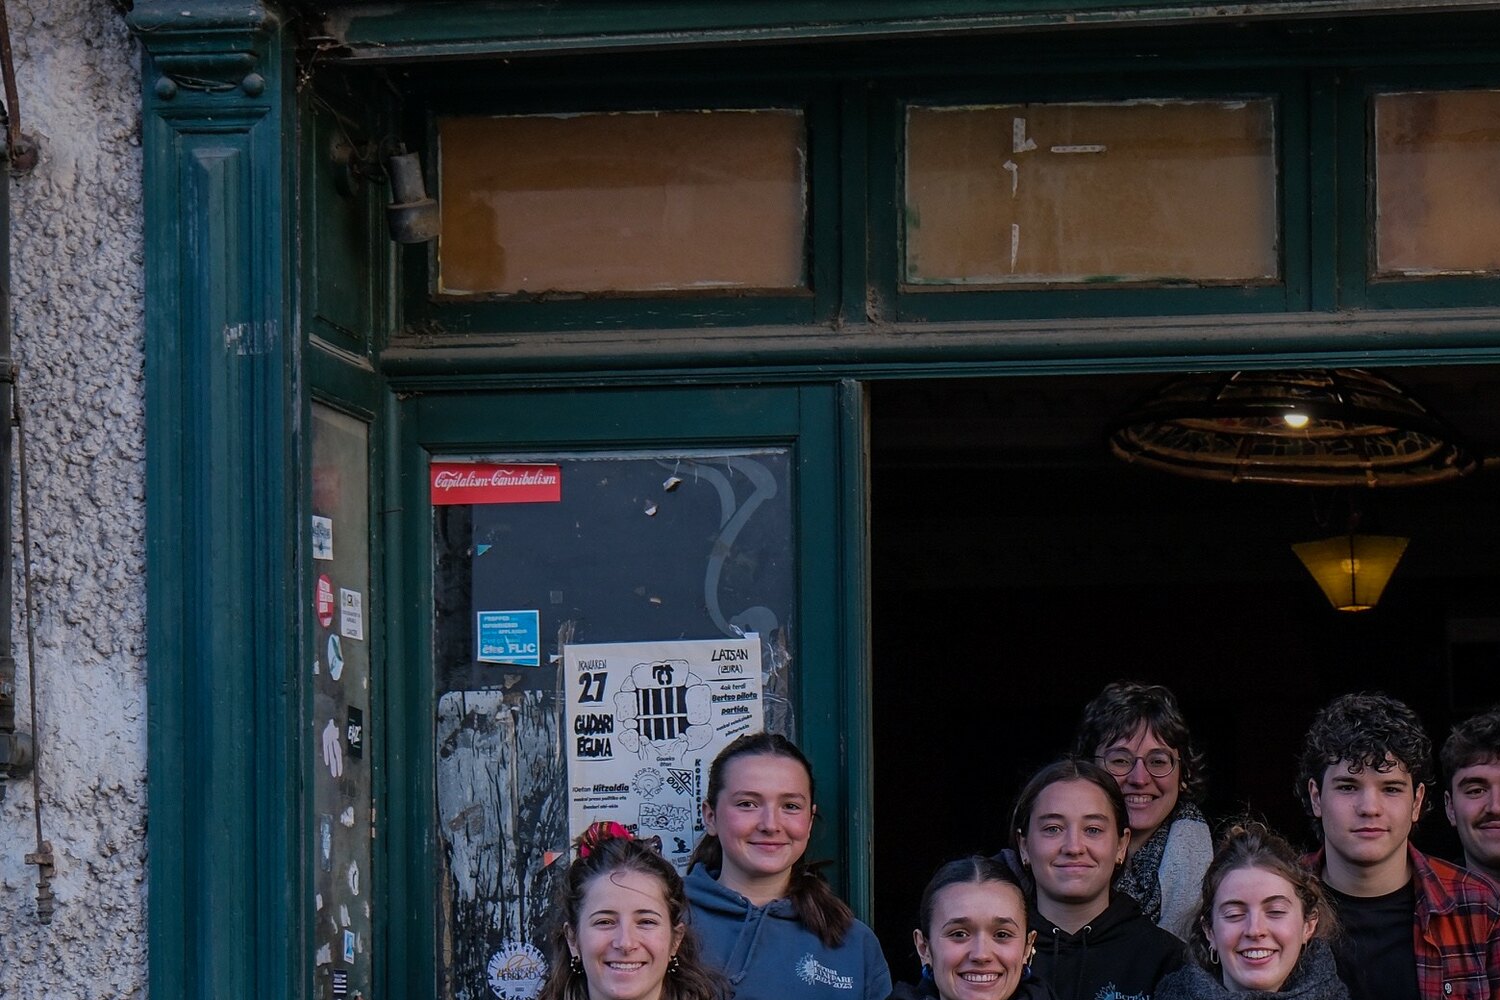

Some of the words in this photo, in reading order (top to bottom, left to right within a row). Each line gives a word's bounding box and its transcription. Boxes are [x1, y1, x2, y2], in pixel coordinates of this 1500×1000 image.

[509, 642, 536, 653] FLIC
[711, 648, 749, 661] LATSAN
[578, 672, 608, 703] 27
[721, 705, 749, 715] partida
[574, 713, 614, 735] GUDARI
[593, 783, 630, 793] Hitzaldia
